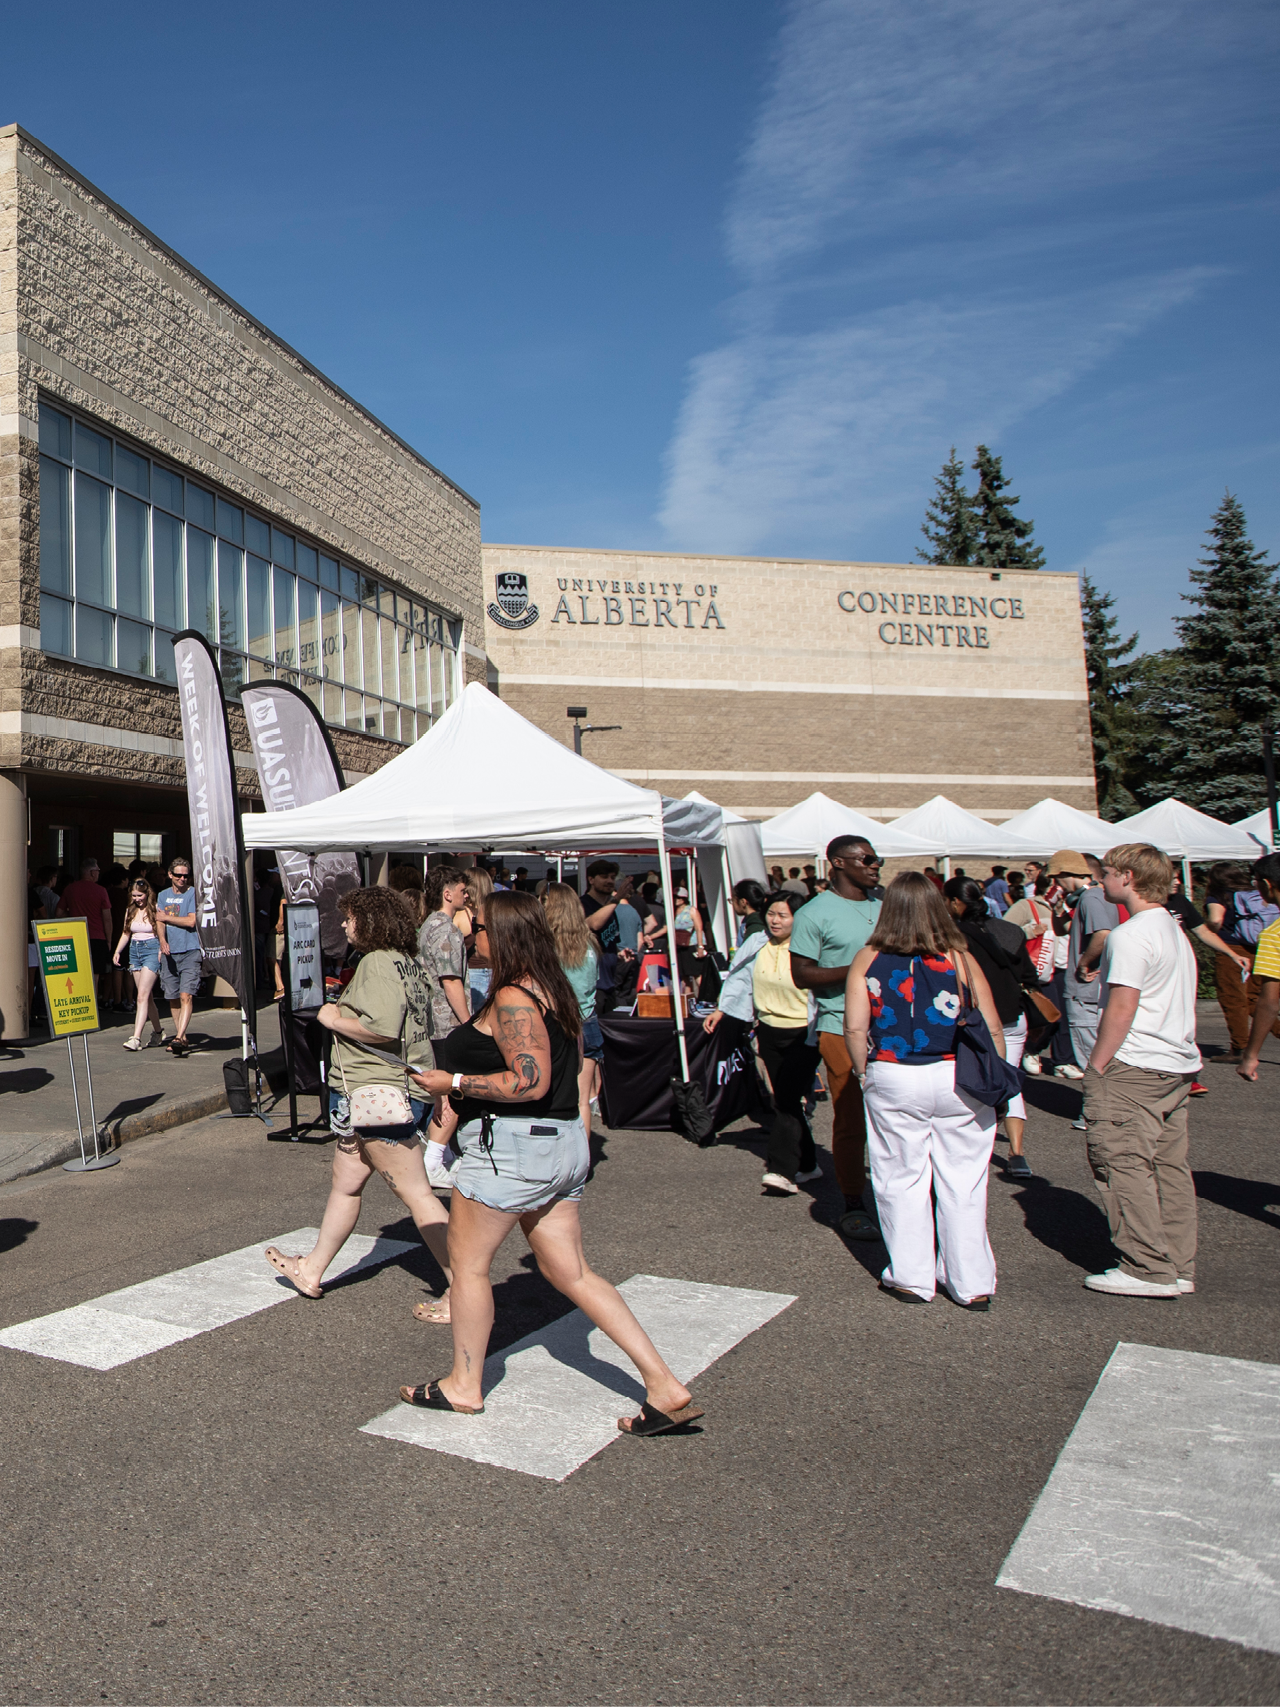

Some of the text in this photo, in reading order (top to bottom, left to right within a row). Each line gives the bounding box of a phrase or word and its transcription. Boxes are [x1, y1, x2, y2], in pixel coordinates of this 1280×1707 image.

[557, 578, 719, 598] UNIVERSITY OF
[551, 594, 727, 630] ALBERTA
[837, 590, 1026, 619] CONFERENCE
[878, 621, 990, 649] CENTRE
[181, 651, 201, 737] WEEK
[192, 740, 206, 778] OF
[195, 781, 217, 929] WELCOME
[44, 944, 72, 954] RESIDENCE
[293, 939, 316, 950] ARC CARD
[46, 954, 62, 963] MOVE
[297, 955, 314, 965] PICKUP
[53, 994, 91, 1007] LATE ARRIVAL
[58, 1006, 90, 1018] KEY PICKUP
